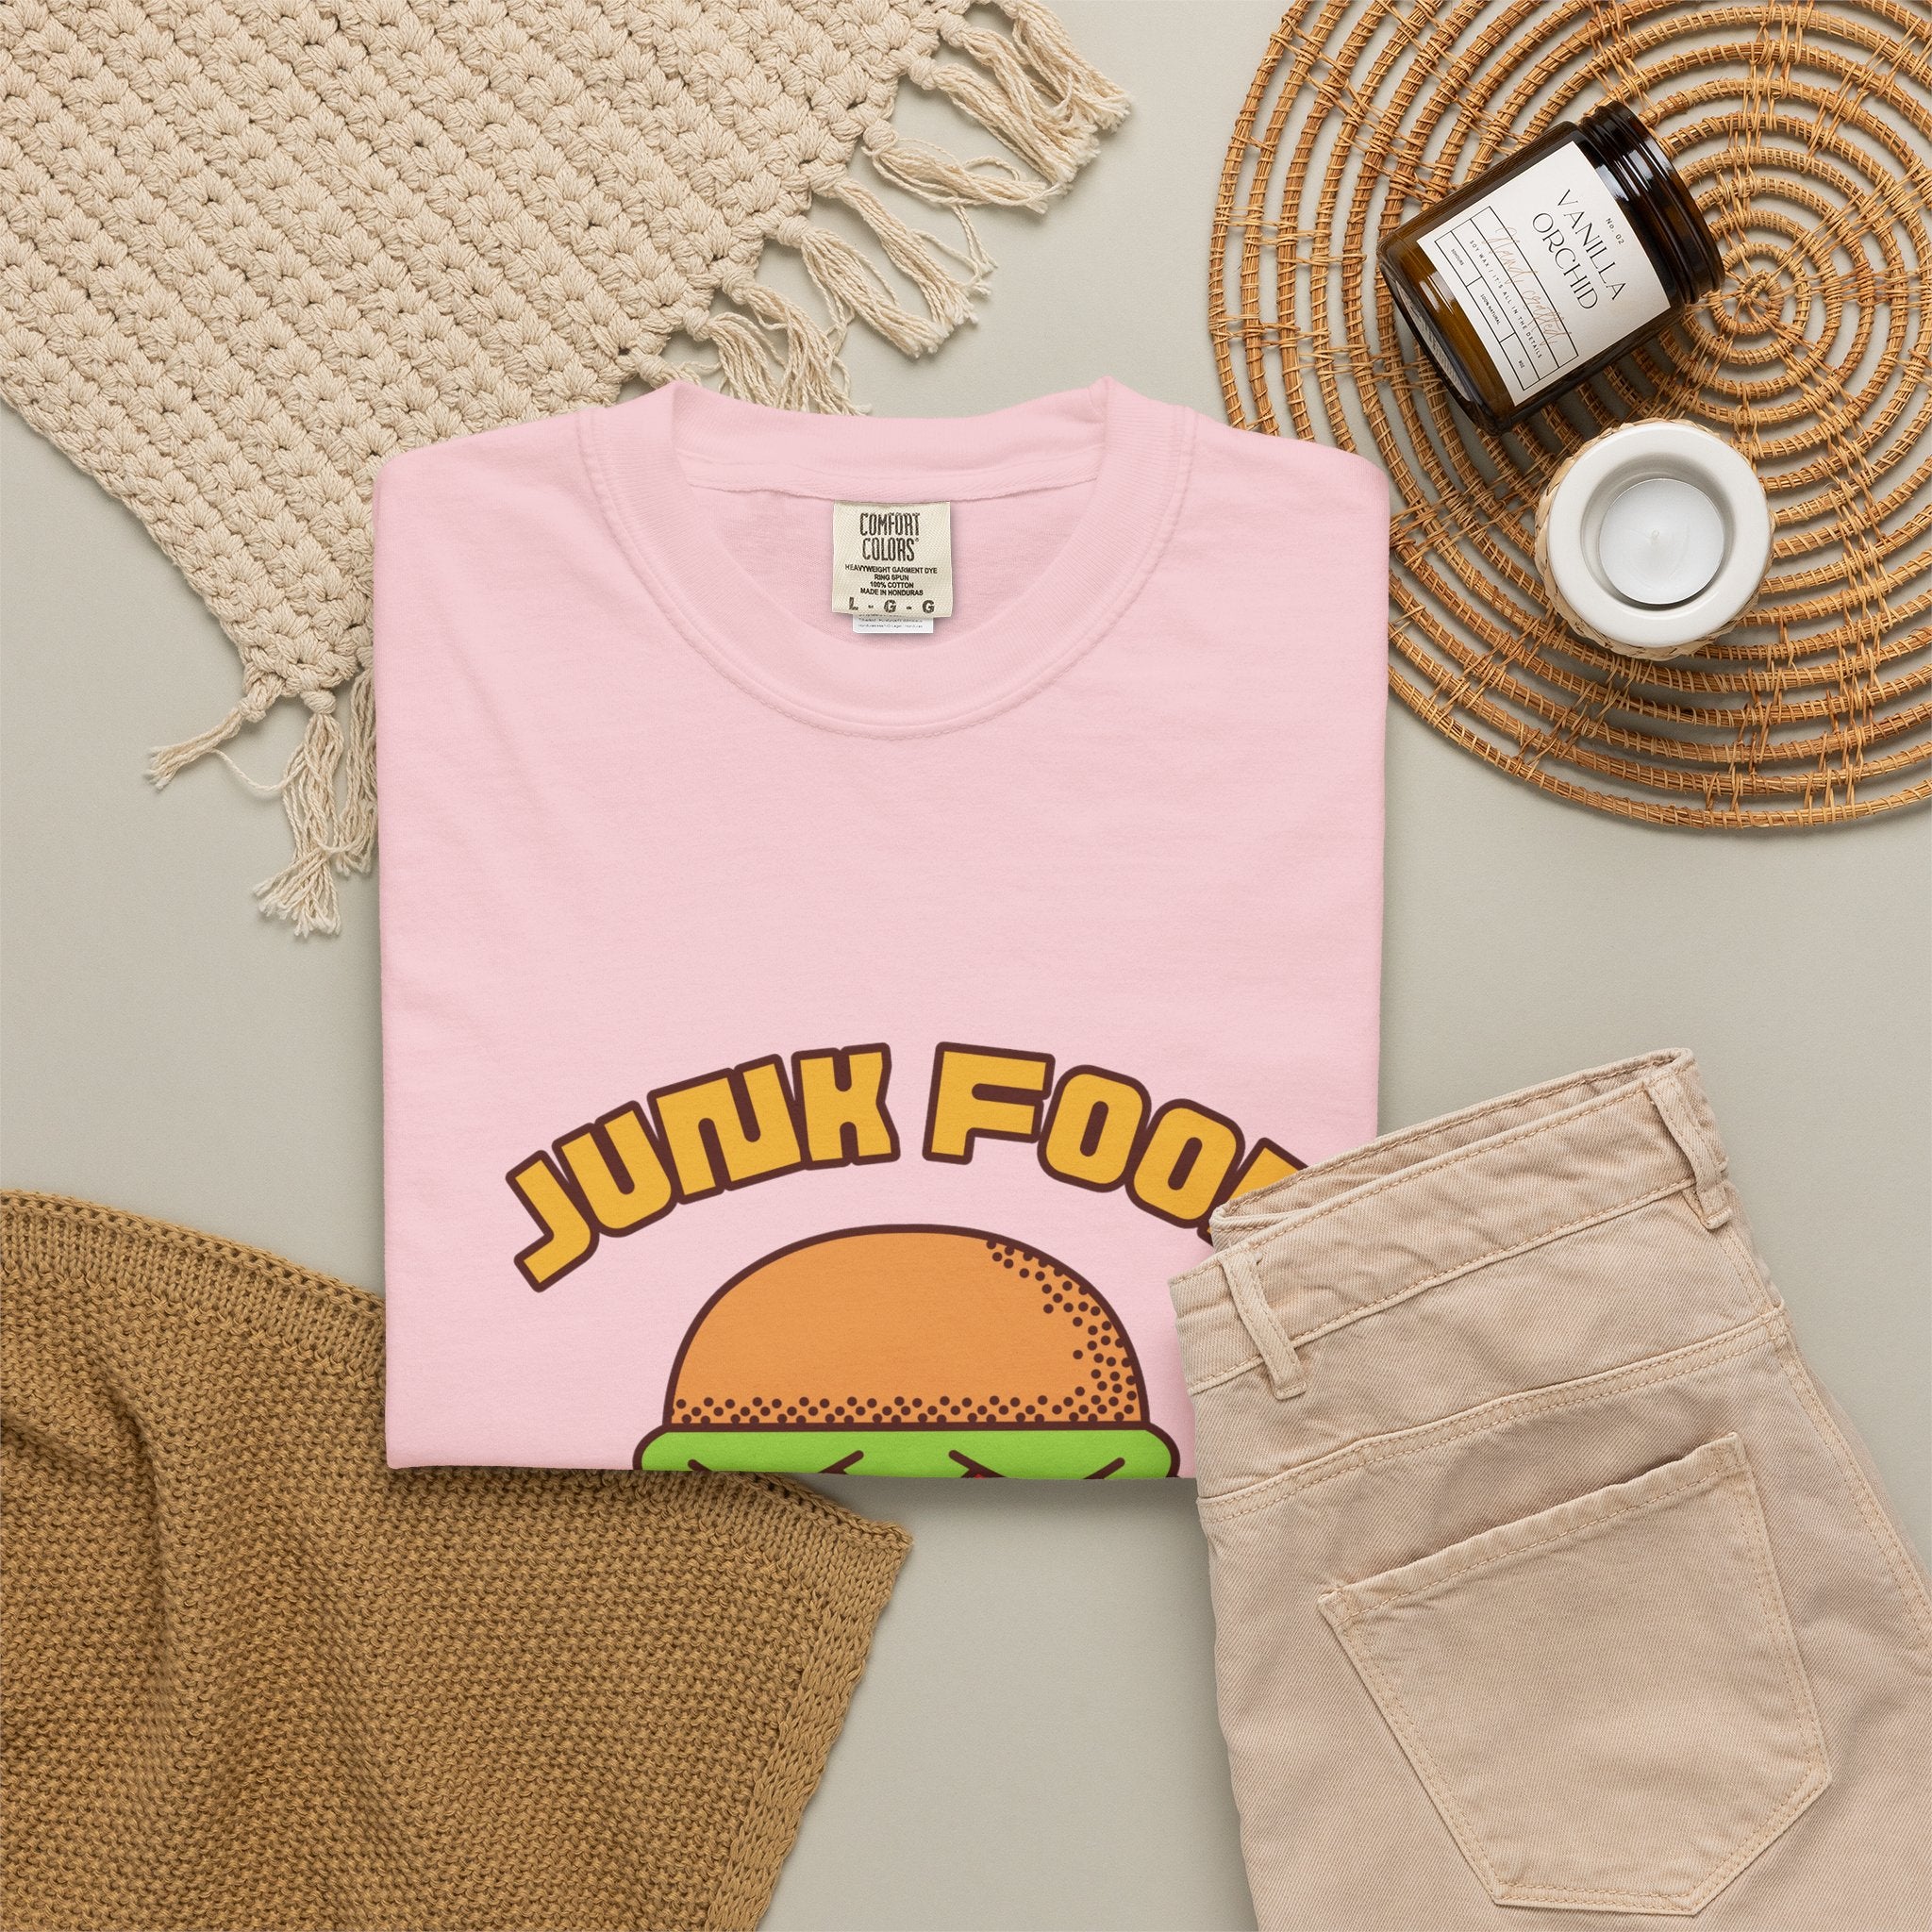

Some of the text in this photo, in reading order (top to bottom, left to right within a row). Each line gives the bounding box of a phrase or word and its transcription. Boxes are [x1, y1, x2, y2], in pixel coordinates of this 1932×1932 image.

[1557, 189, 1628, 301] VANILLA
[1615, 234, 1625, 245] 02
[1531, 212, 1601, 310] ORCHID
[1470, 240, 1479, 252] SOY
[1478, 255, 1489, 268] WAX
[1502, 291, 1512, 304] ALL
[1511, 306, 1518, 315] IN
[1517, 317, 1527, 330] THE
[1526, 332, 1542, 358] DETAILS
[1479, 293, 1490, 308] 100%
[859, 512, 920, 536] COMFORT
[845, 563, 891, 574] HEAVYWEIGHT
[891, 566, 924, 575] GARMENT
[860, 587, 924, 596] MADE IN HONDURAS
[848, 596, 859, 611] L
[883, 599, 897, 613] G
[922, 600, 935, 614] G
[506, 1042, 900, 1292] JUNK
